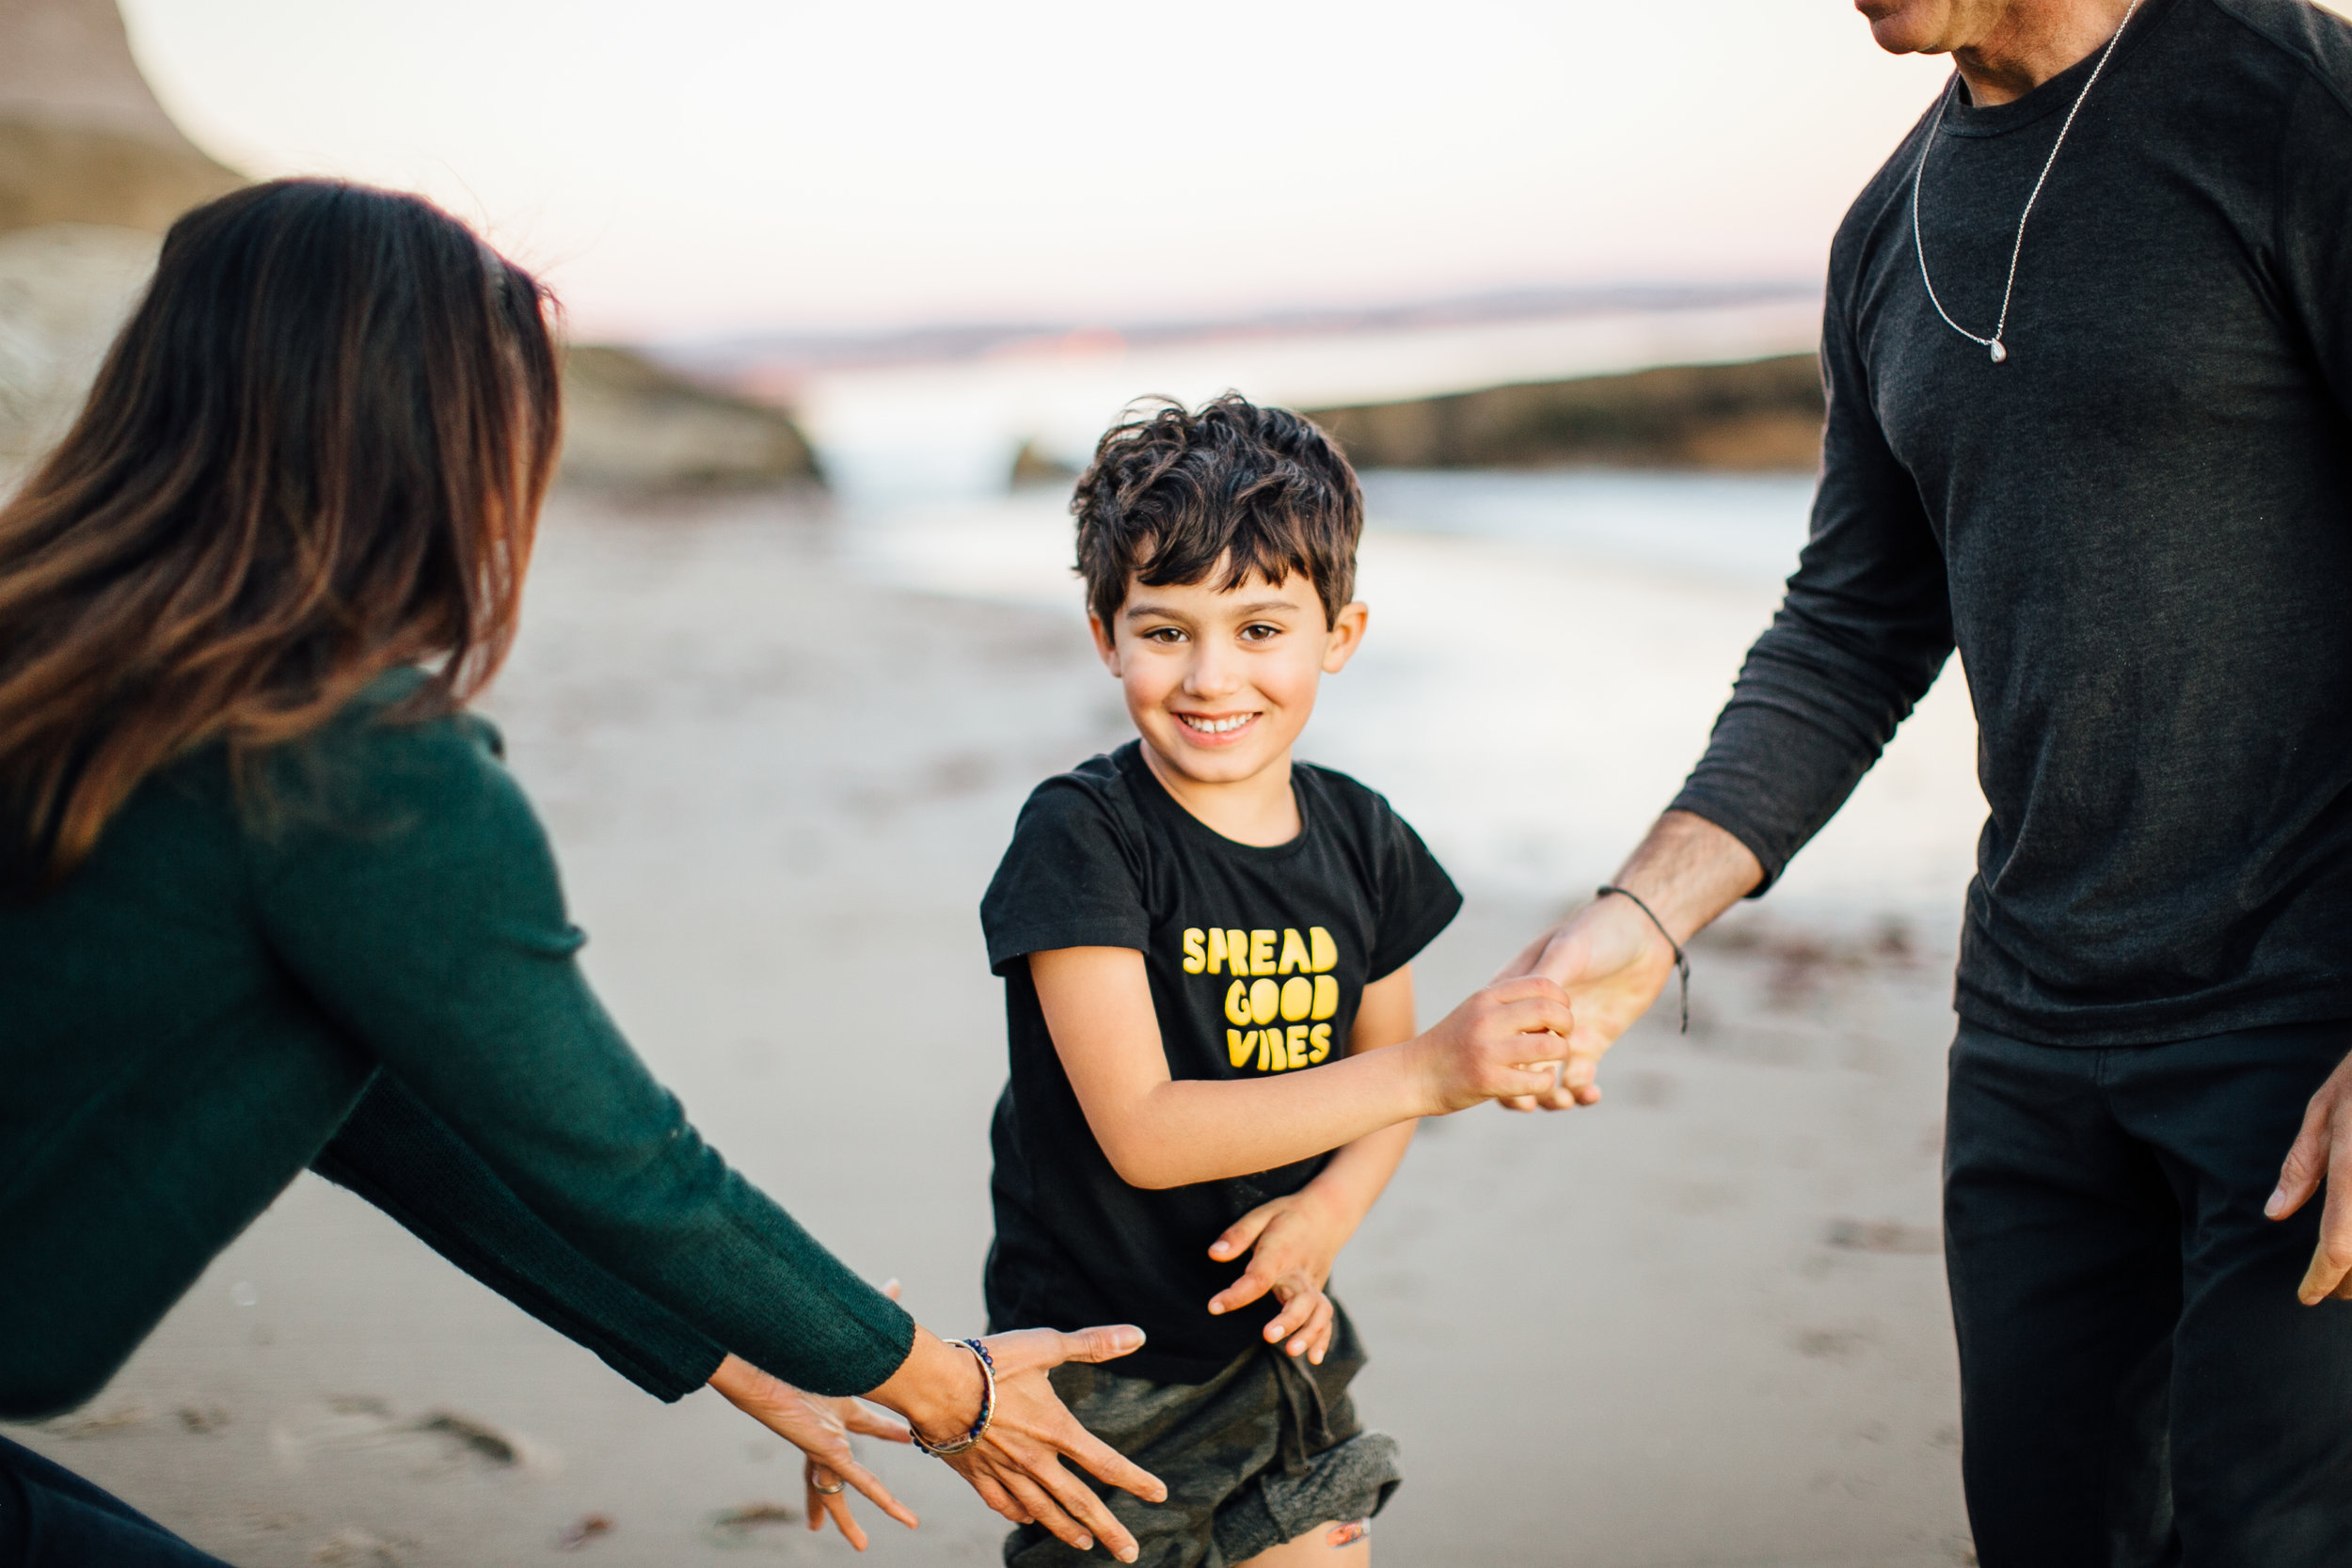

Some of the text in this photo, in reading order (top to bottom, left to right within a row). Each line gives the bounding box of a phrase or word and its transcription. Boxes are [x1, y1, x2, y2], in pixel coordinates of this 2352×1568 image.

[1183, 927, 1338, 976] SPREAD
[1225, 974, 1339, 1025] GOOD
[1226, 1022, 1333, 1071] VIBES
